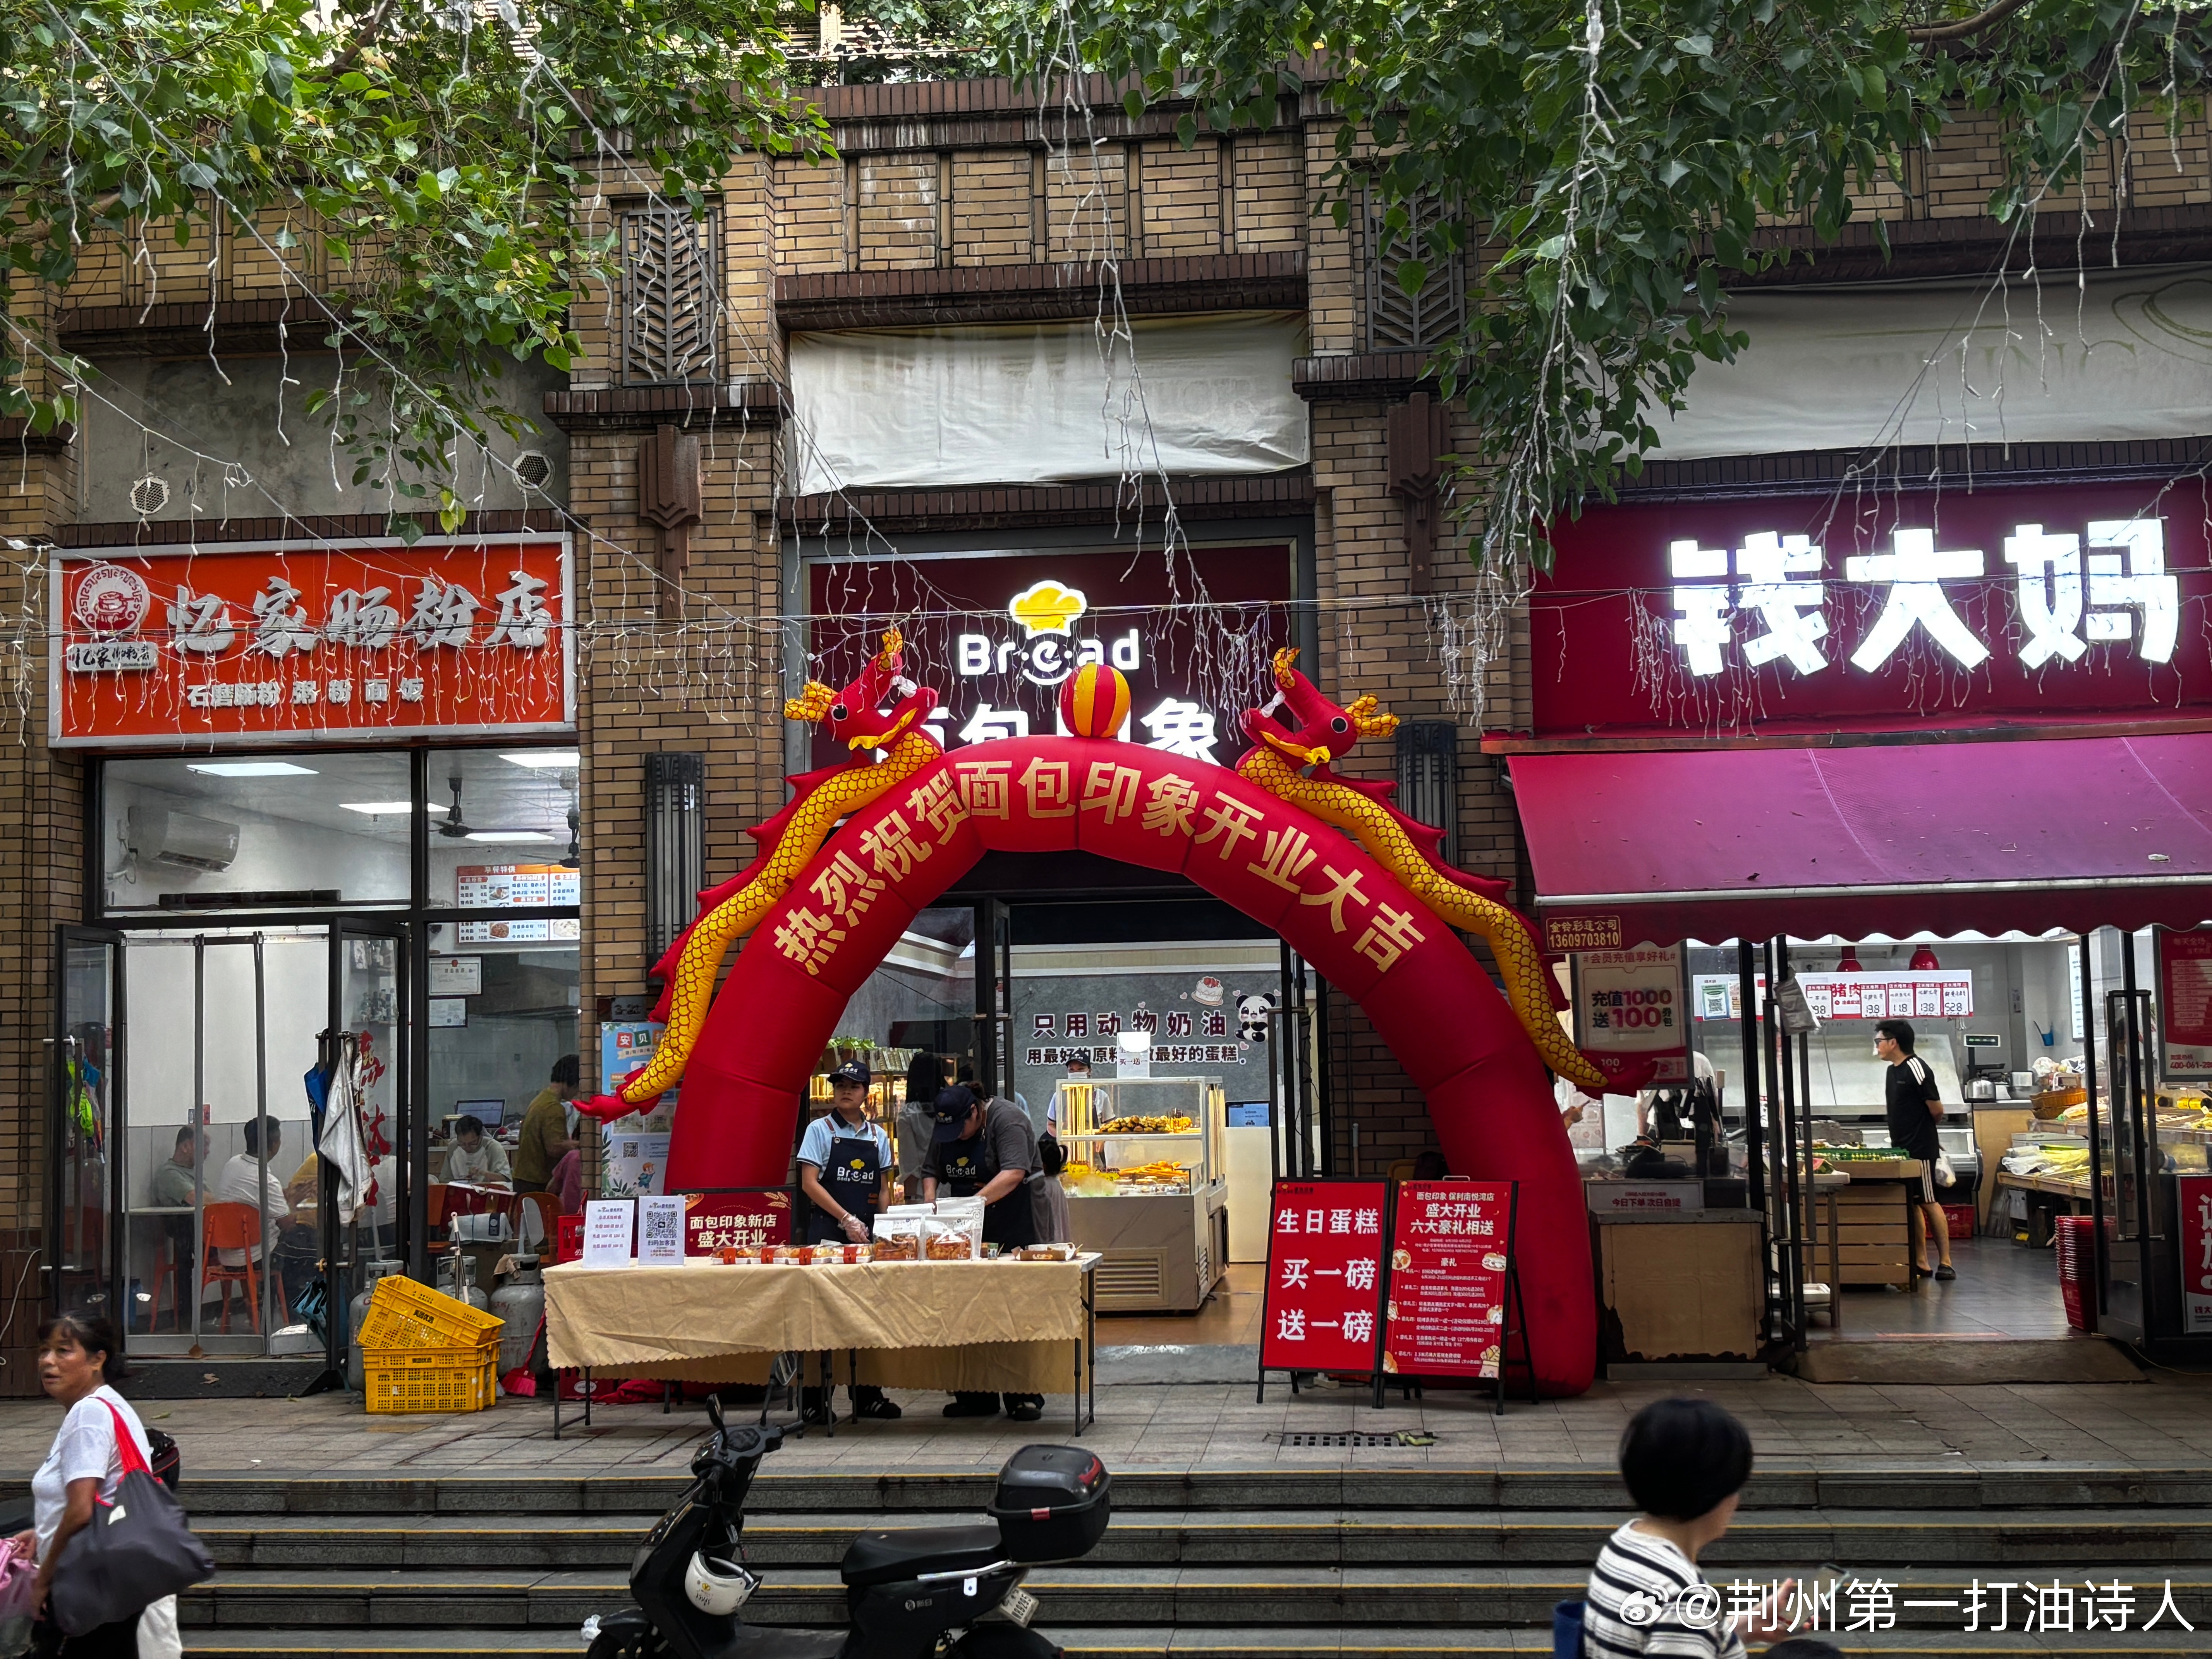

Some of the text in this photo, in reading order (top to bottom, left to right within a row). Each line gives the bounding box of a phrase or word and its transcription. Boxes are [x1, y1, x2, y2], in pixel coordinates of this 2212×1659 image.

[1671, 519, 2178, 675] 钱大妈
[167, 571, 551, 657] 忆家肠粉店
[959, 629, 1139, 677] Bread
[187, 682, 280, 707] 石磨肠粉
[365, 678, 388, 702] 面
[1550, 932, 1619, 948] 13609703810
[1592, 989, 1672, 1006] 充值1000
[1831, 983, 1860, 997] 猪肉
[1032, 1009, 1227, 1039] 只用动物奶油
[1592, 1007, 1661, 1028] 送100
[837, 1166, 874, 1180] Bread
[1417, 1192, 1446, 1200] 面包印象
[1425, 1203, 1481, 1218] 盛大开业
[690, 1213, 777, 1230] 面包印象新店
[1277, 1208, 1378, 1234] 生日蛋糕
[1410, 1219, 1494, 1235] 六大豪礼相送
[697, 1229, 767, 1248] 盛大开业
[1441, 1257, 1457, 1267] 豪礼
[1281, 1257, 1376, 1290] 买一磅
[1277, 1309, 1372, 1343] 送一磅
